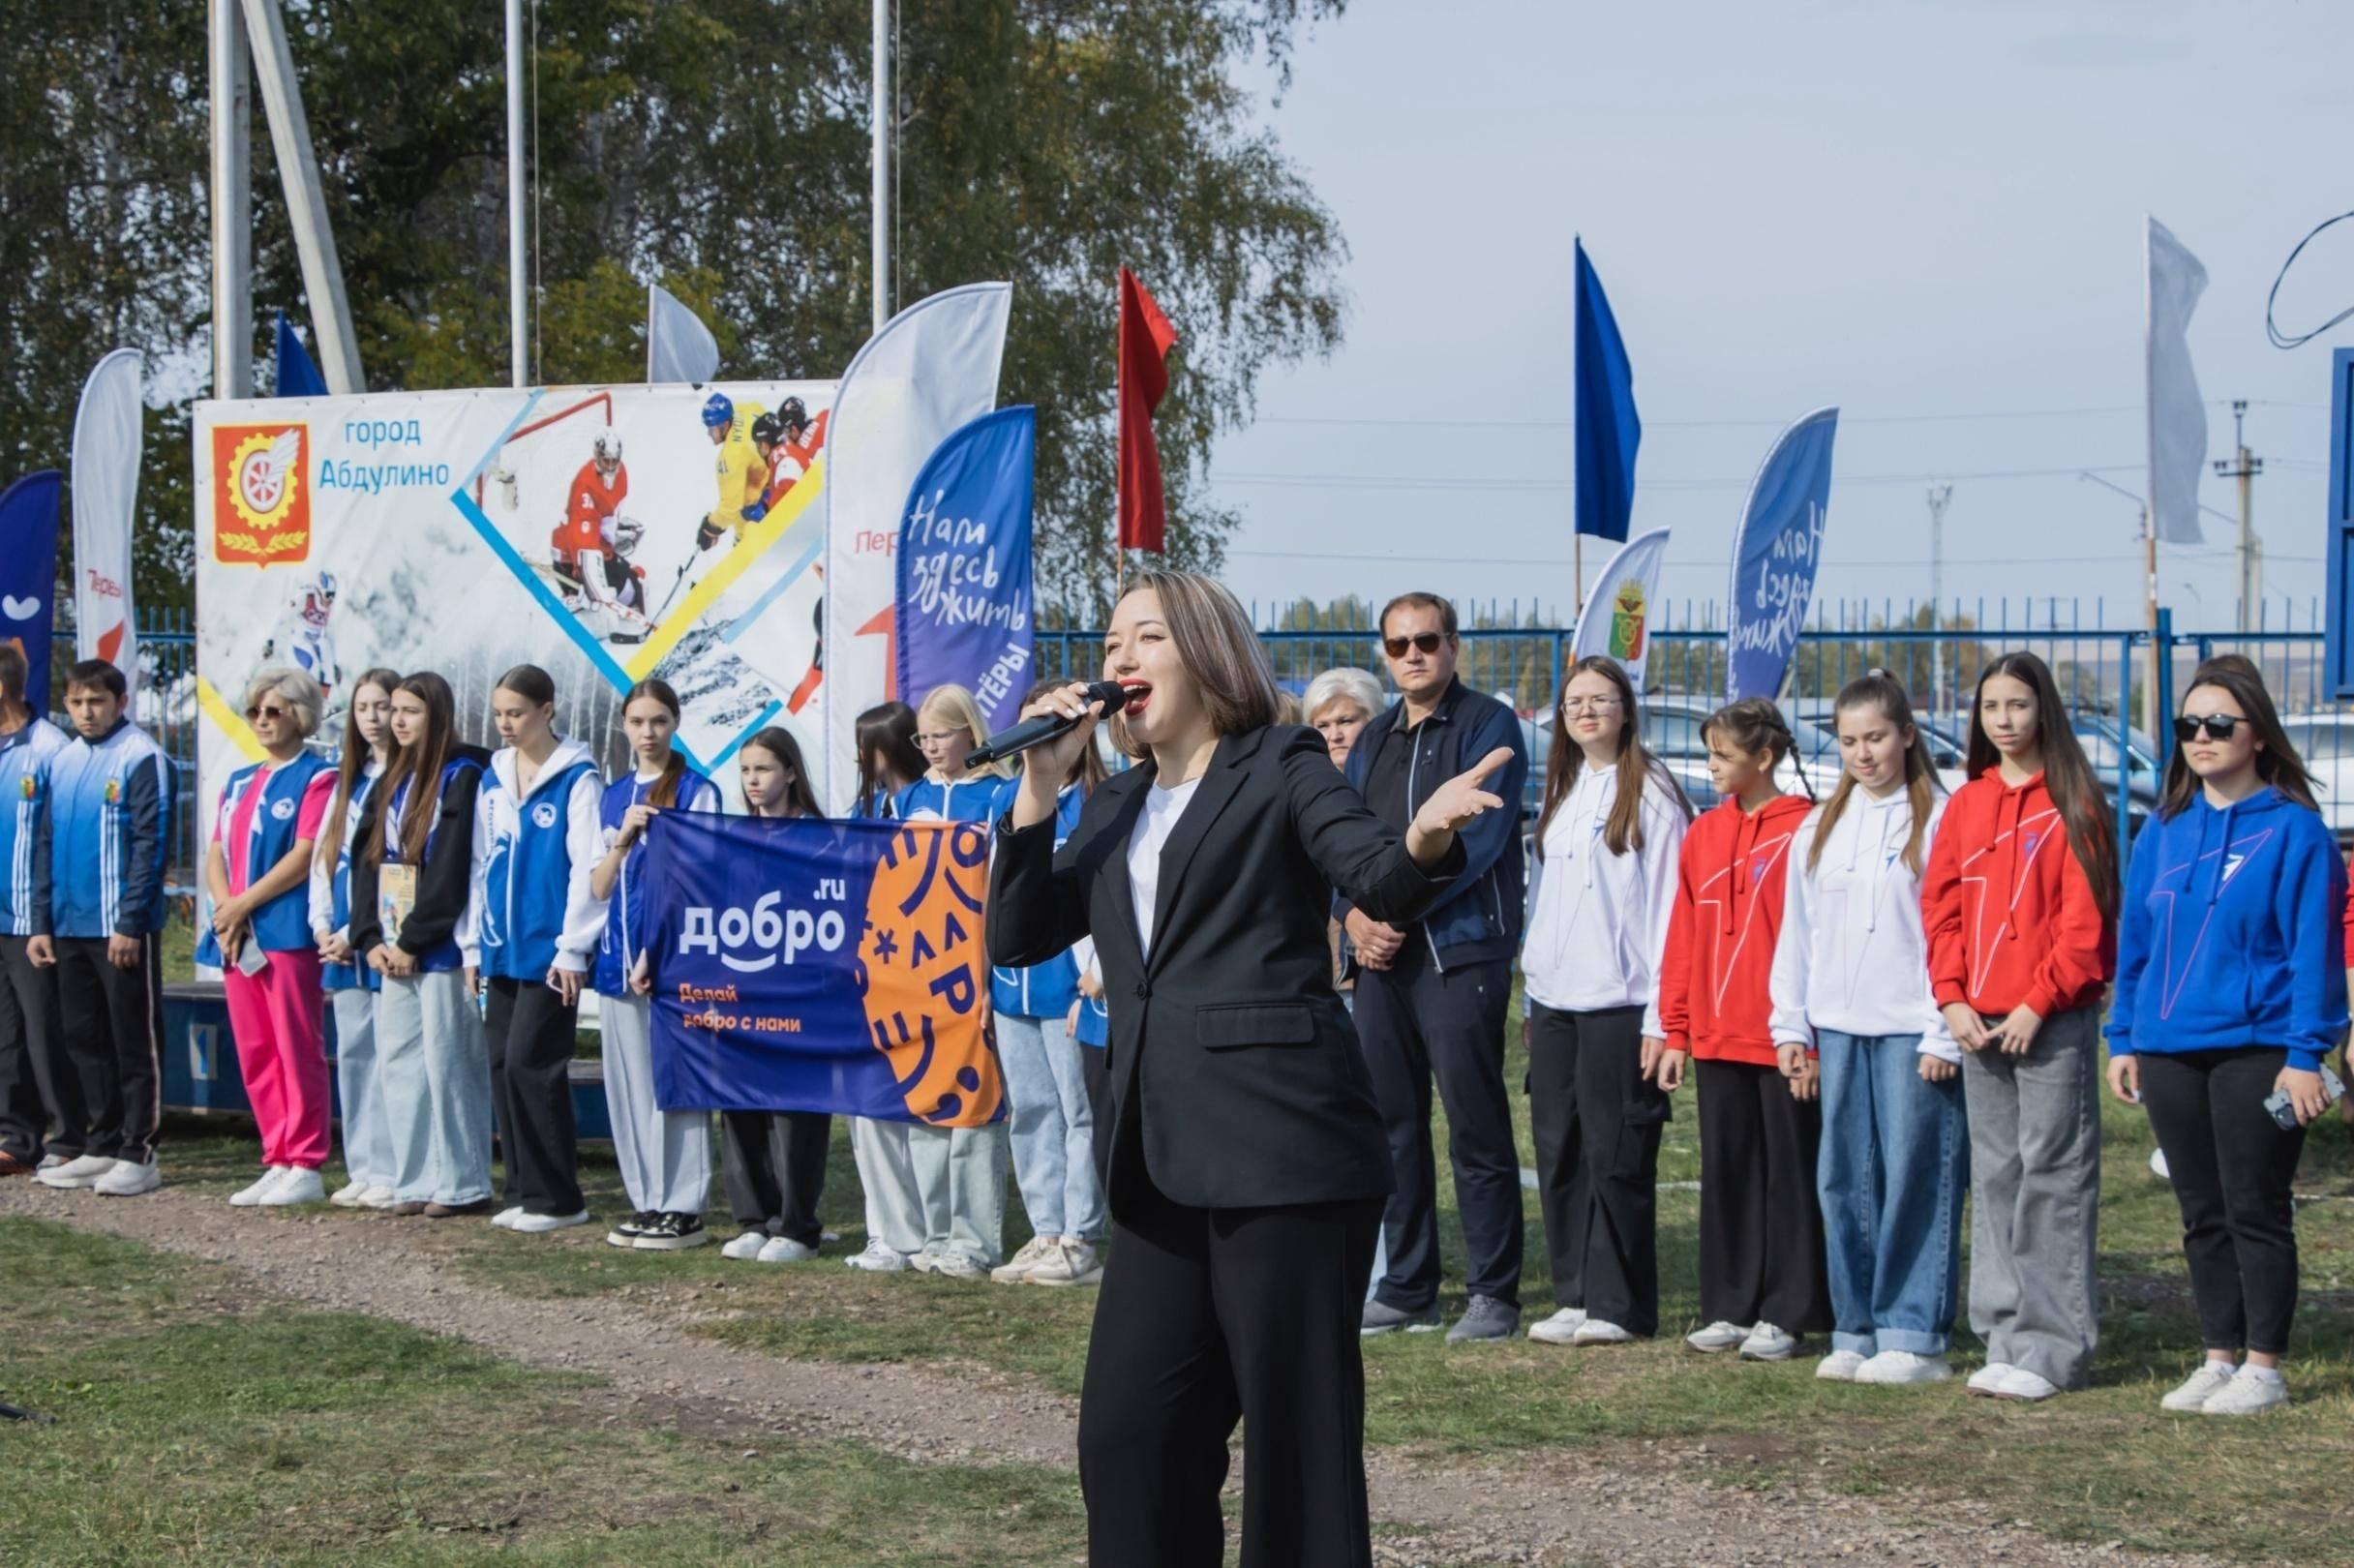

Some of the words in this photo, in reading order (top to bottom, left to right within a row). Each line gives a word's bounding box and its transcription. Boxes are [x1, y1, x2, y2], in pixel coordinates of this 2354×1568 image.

[345, 419, 421, 451] город
[318, 459, 450, 496] Абдулино
[907, 489, 986, 549] Нам
[907, 544, 1000, 615] здесь
[935, 585, 1026, 632] жить
[813, 878, 846, 901] .ru
[679, 890, 846, 965] добро
[679, 982, 739, 1004] Делай
[740, 1017, 751, 1030] с
[755, 1017, 801, 1033] нами
